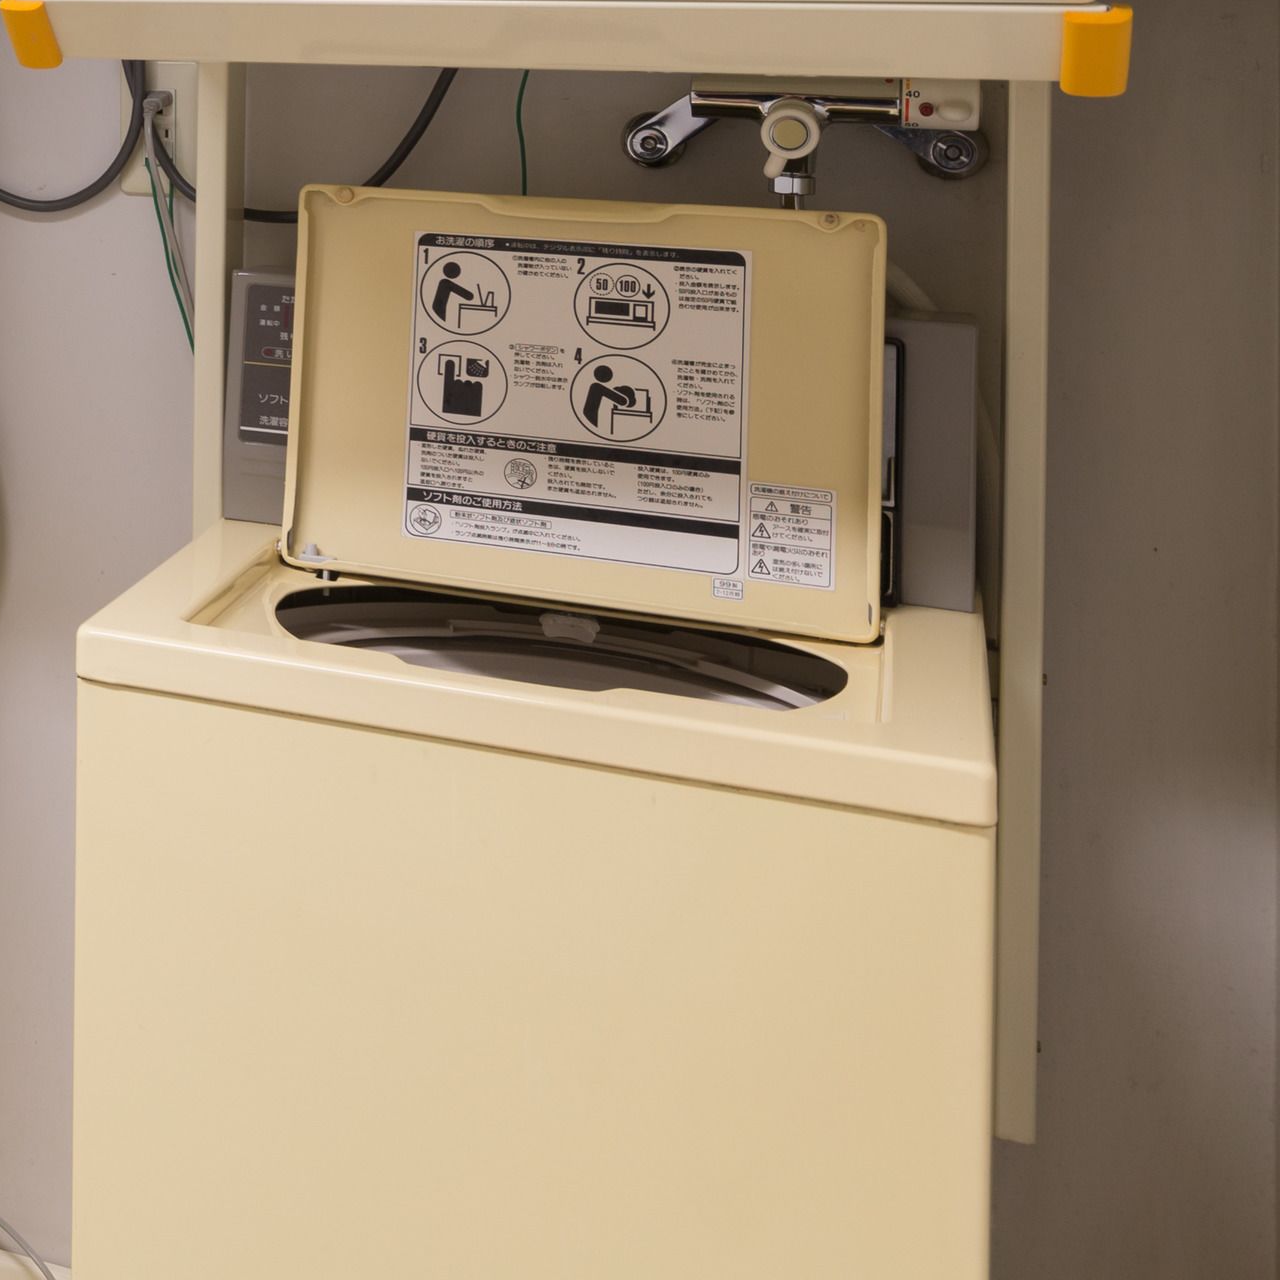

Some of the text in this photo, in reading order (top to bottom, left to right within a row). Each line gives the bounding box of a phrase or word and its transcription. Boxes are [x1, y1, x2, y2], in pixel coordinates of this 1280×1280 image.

[906, 90, 920, 98] 40
[436, 236, 495, 248] お洗濯の順序
[423, 248, 429, 264] 1
[577, 258, 585, 274] 2
[596, 279, 636, 293] 50 100
[419, 337, 427, 353] 3
[574, 348, 582, 364] 4
[259, 393, 288, 404] ソフト
[426, 432, 557, 453] 硬貨を投入するときのご注意
[423, 491, 522, 511] ソフト剤のご使用方法
[790, 504, 812, 515] 警告
